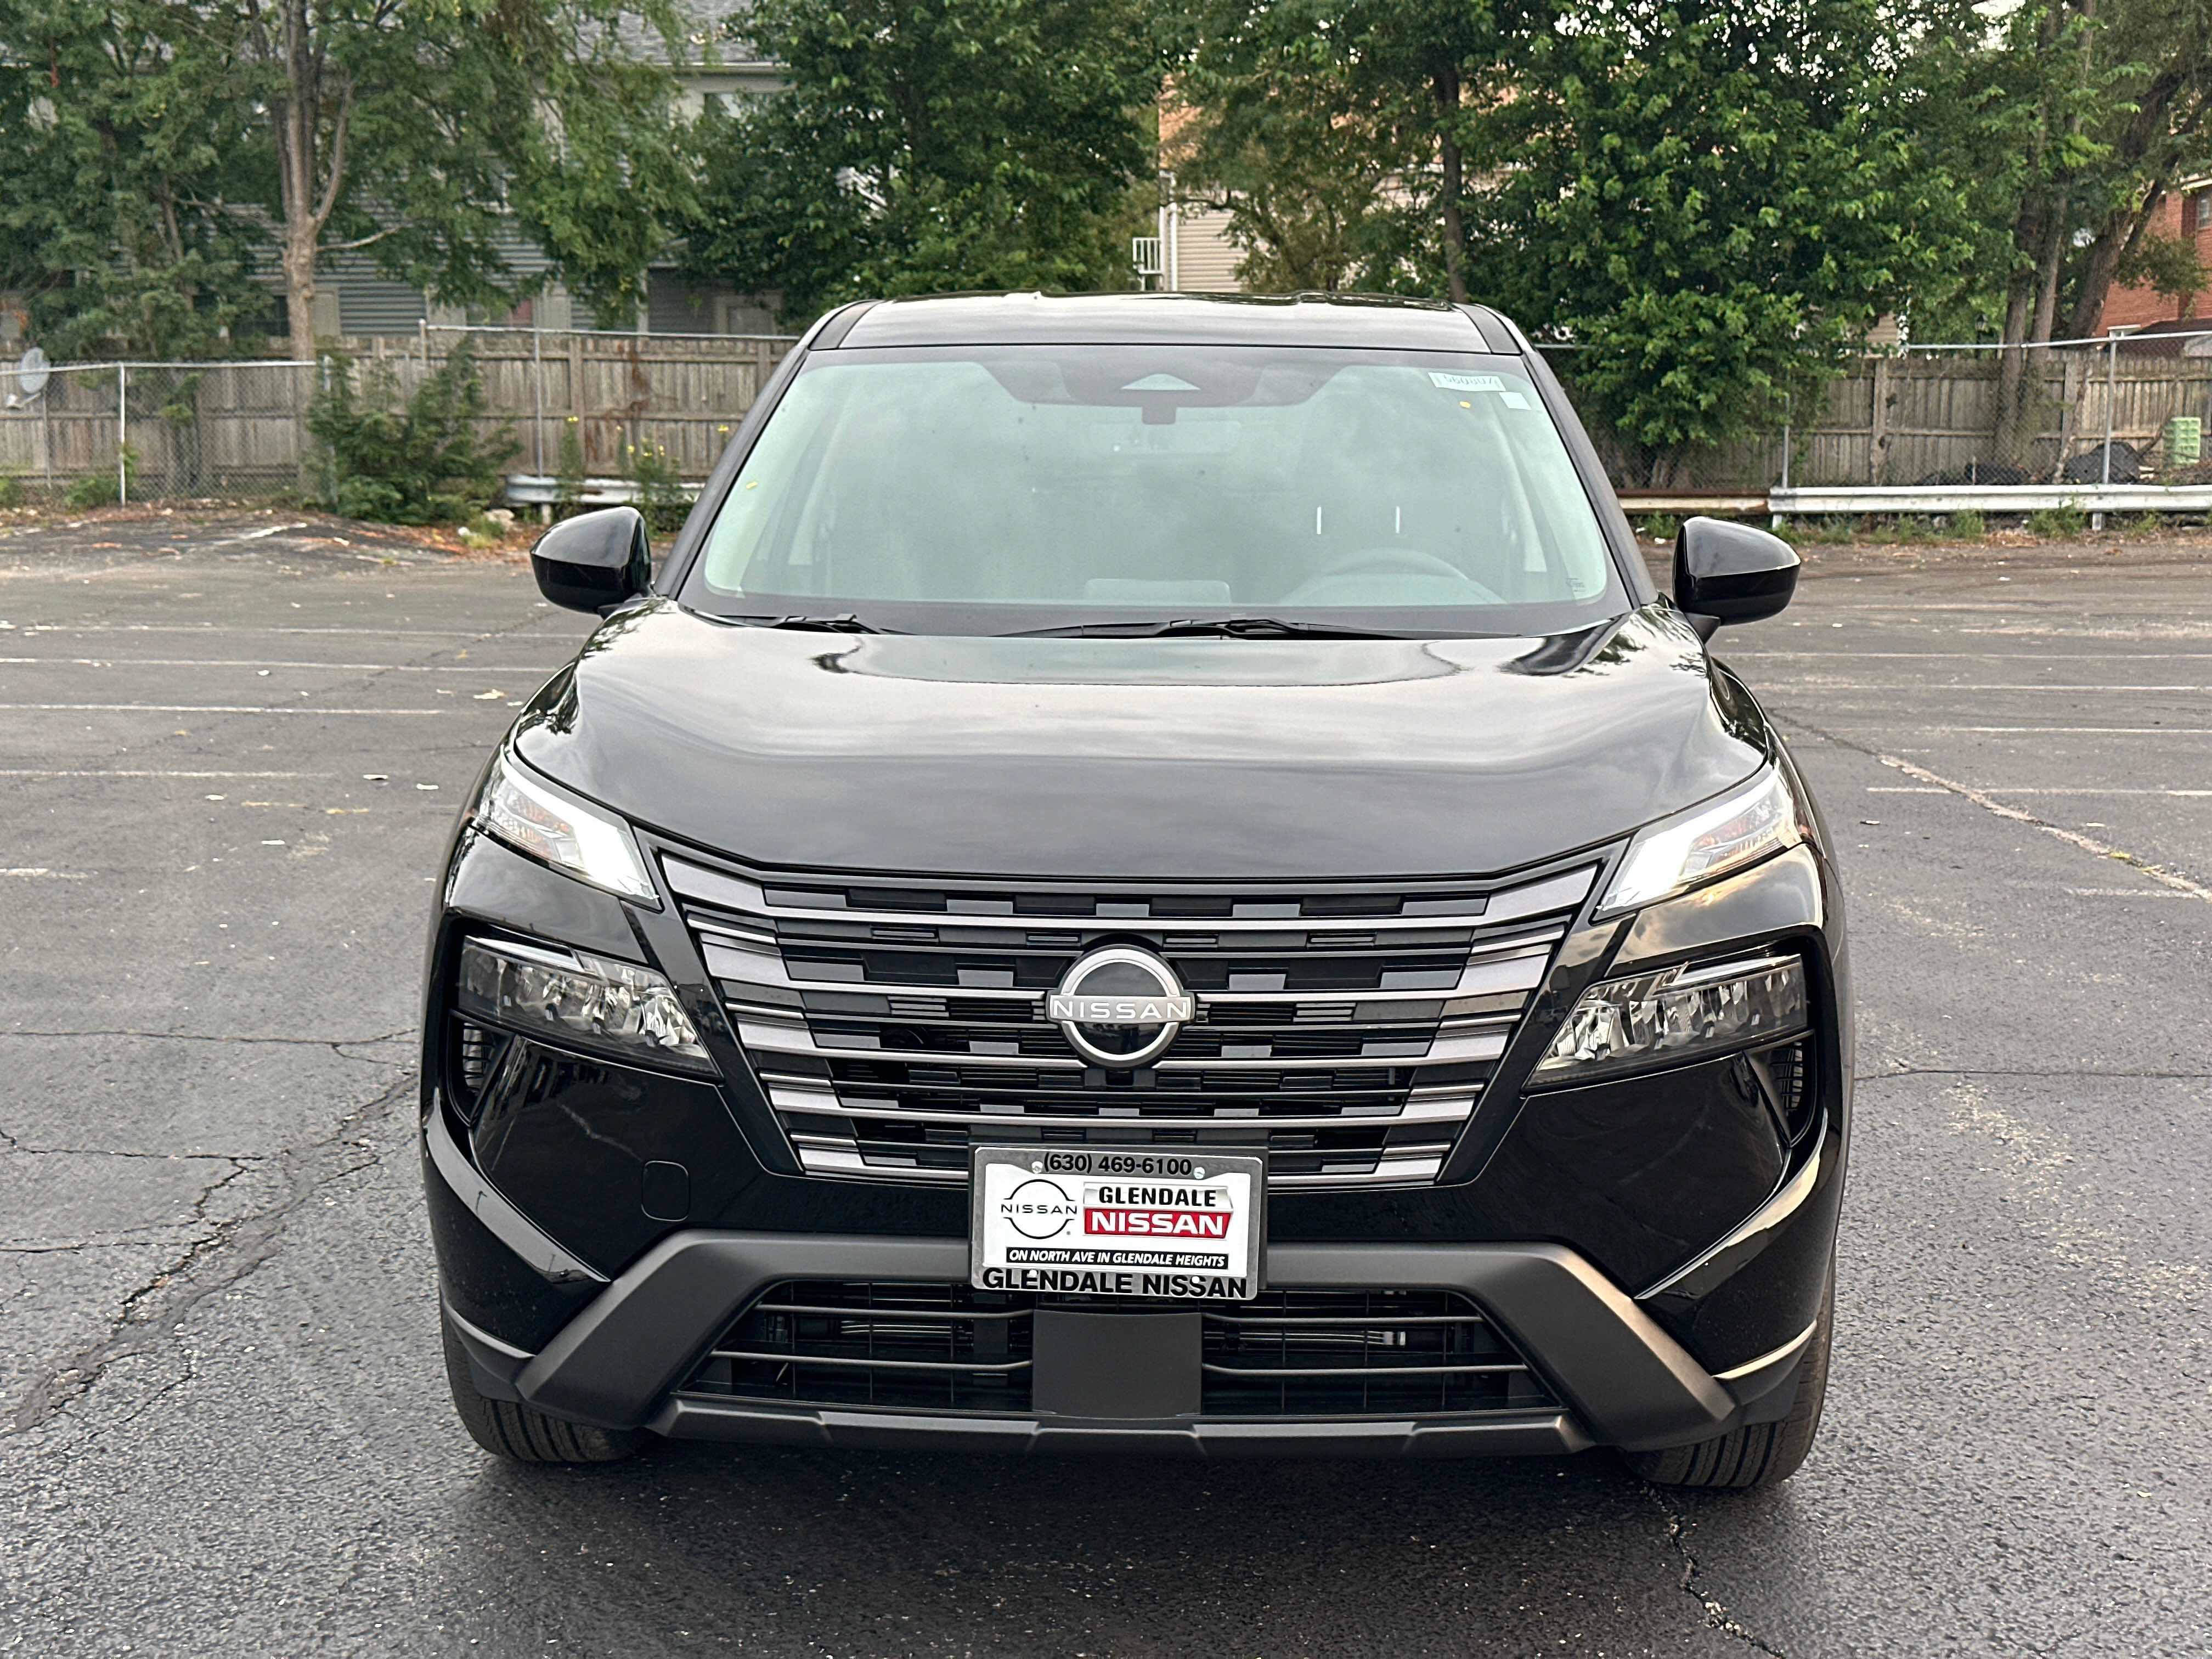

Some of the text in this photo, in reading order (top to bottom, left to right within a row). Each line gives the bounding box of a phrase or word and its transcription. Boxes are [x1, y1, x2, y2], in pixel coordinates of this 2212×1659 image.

[1053, 1000, 1187, 1019] NISSAN
[1043, 1152, 1192, 1176] (630) 469-6100
[1099, 1186, 1216, 1207] GLENDALE
[1001, 1204, 1077, 1214] NISSAN
[1091, 1211, 1223, 1235] NISSAN
[1009, 1249, 1224, 1267] ON NORTH AVE IN GLENDALE HEIGHTS
[983, 1267, 1246, 1297] GLENDALE NISSAN
